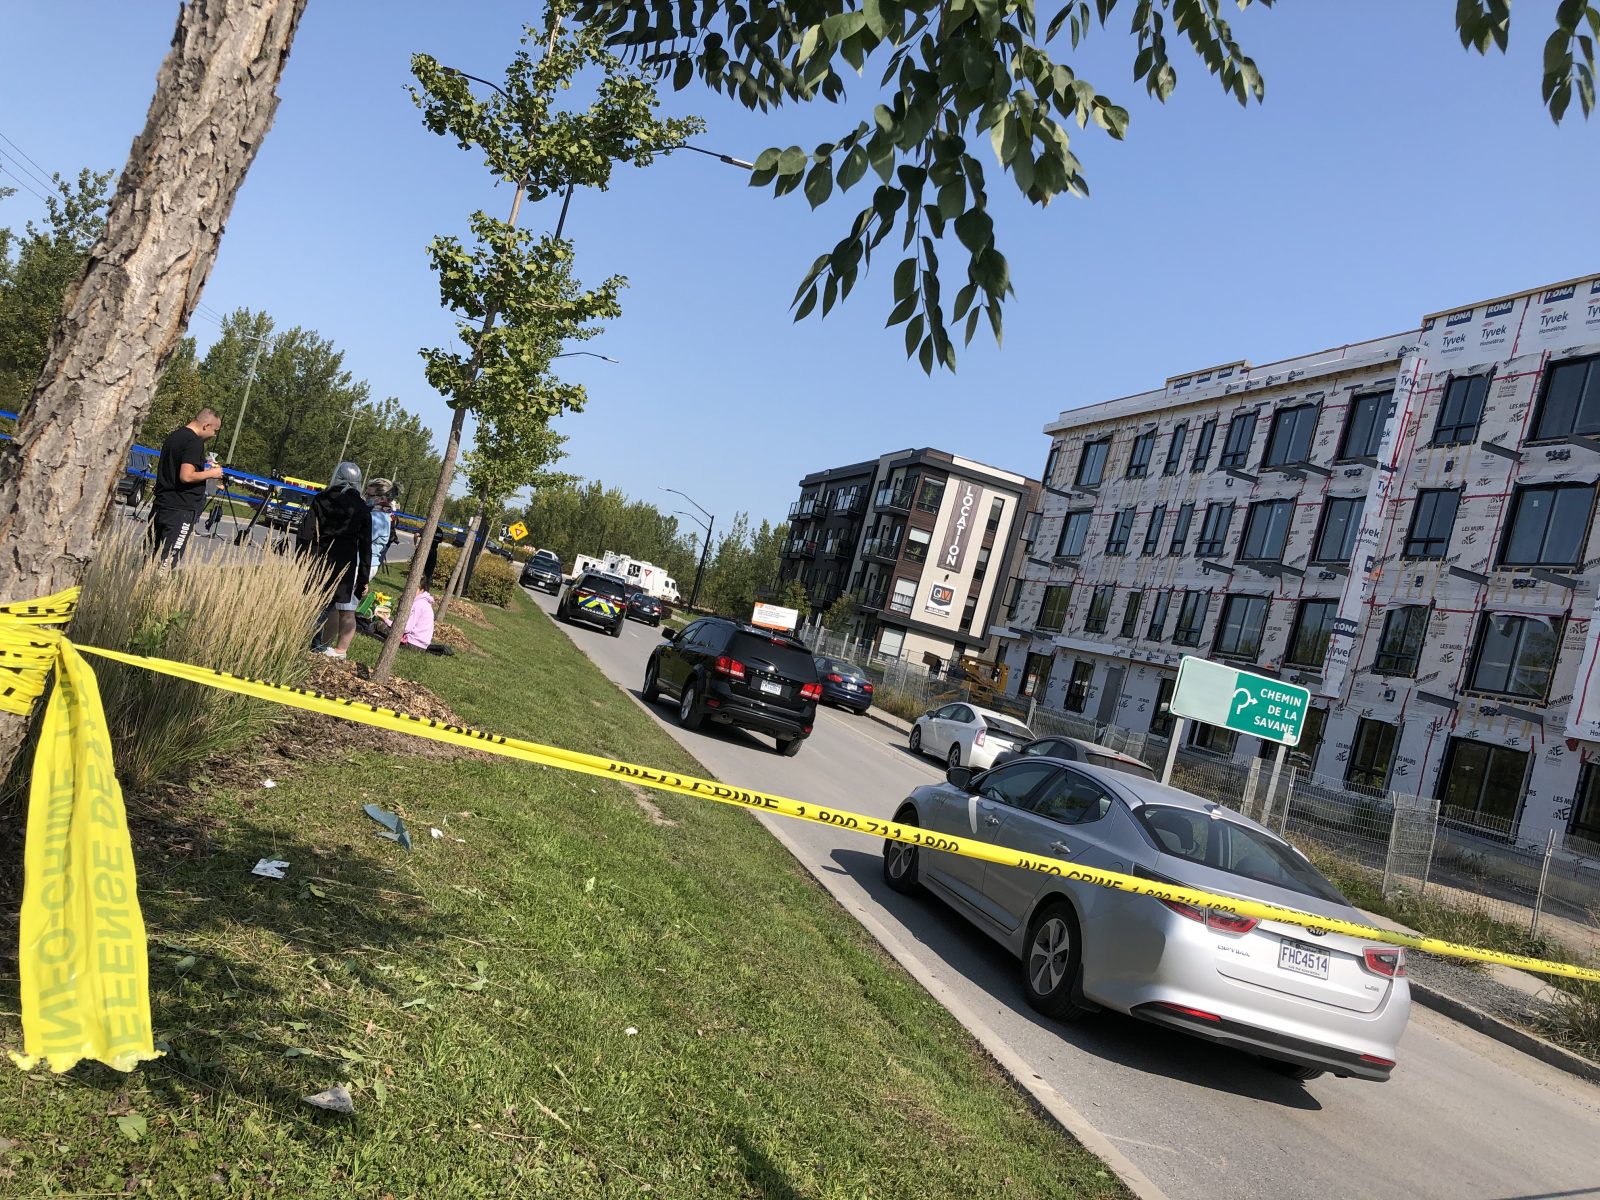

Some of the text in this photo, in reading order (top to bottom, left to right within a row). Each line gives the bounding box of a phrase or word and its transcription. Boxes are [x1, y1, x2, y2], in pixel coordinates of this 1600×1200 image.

[1488, 301, 1513, 313] RONA
[1588, 305, 1600, 316] Tyv
[1448, 310, 1472, 322] RONA
[1540, 311, 1568, 326] Tyvek
[1481, 325, 1507, 339] Tyvek
[1442, 333, 1466, 347] Tyvek
[946, 485, 974, 567] LOCATION
[1260, 688, 1302, 708] CHEMIN
[1267, 705, 1297, 721] DE LA
[1254, 715, 1295, 735] SAVANE
[1281, 946, 1328, 973] FHC4514
